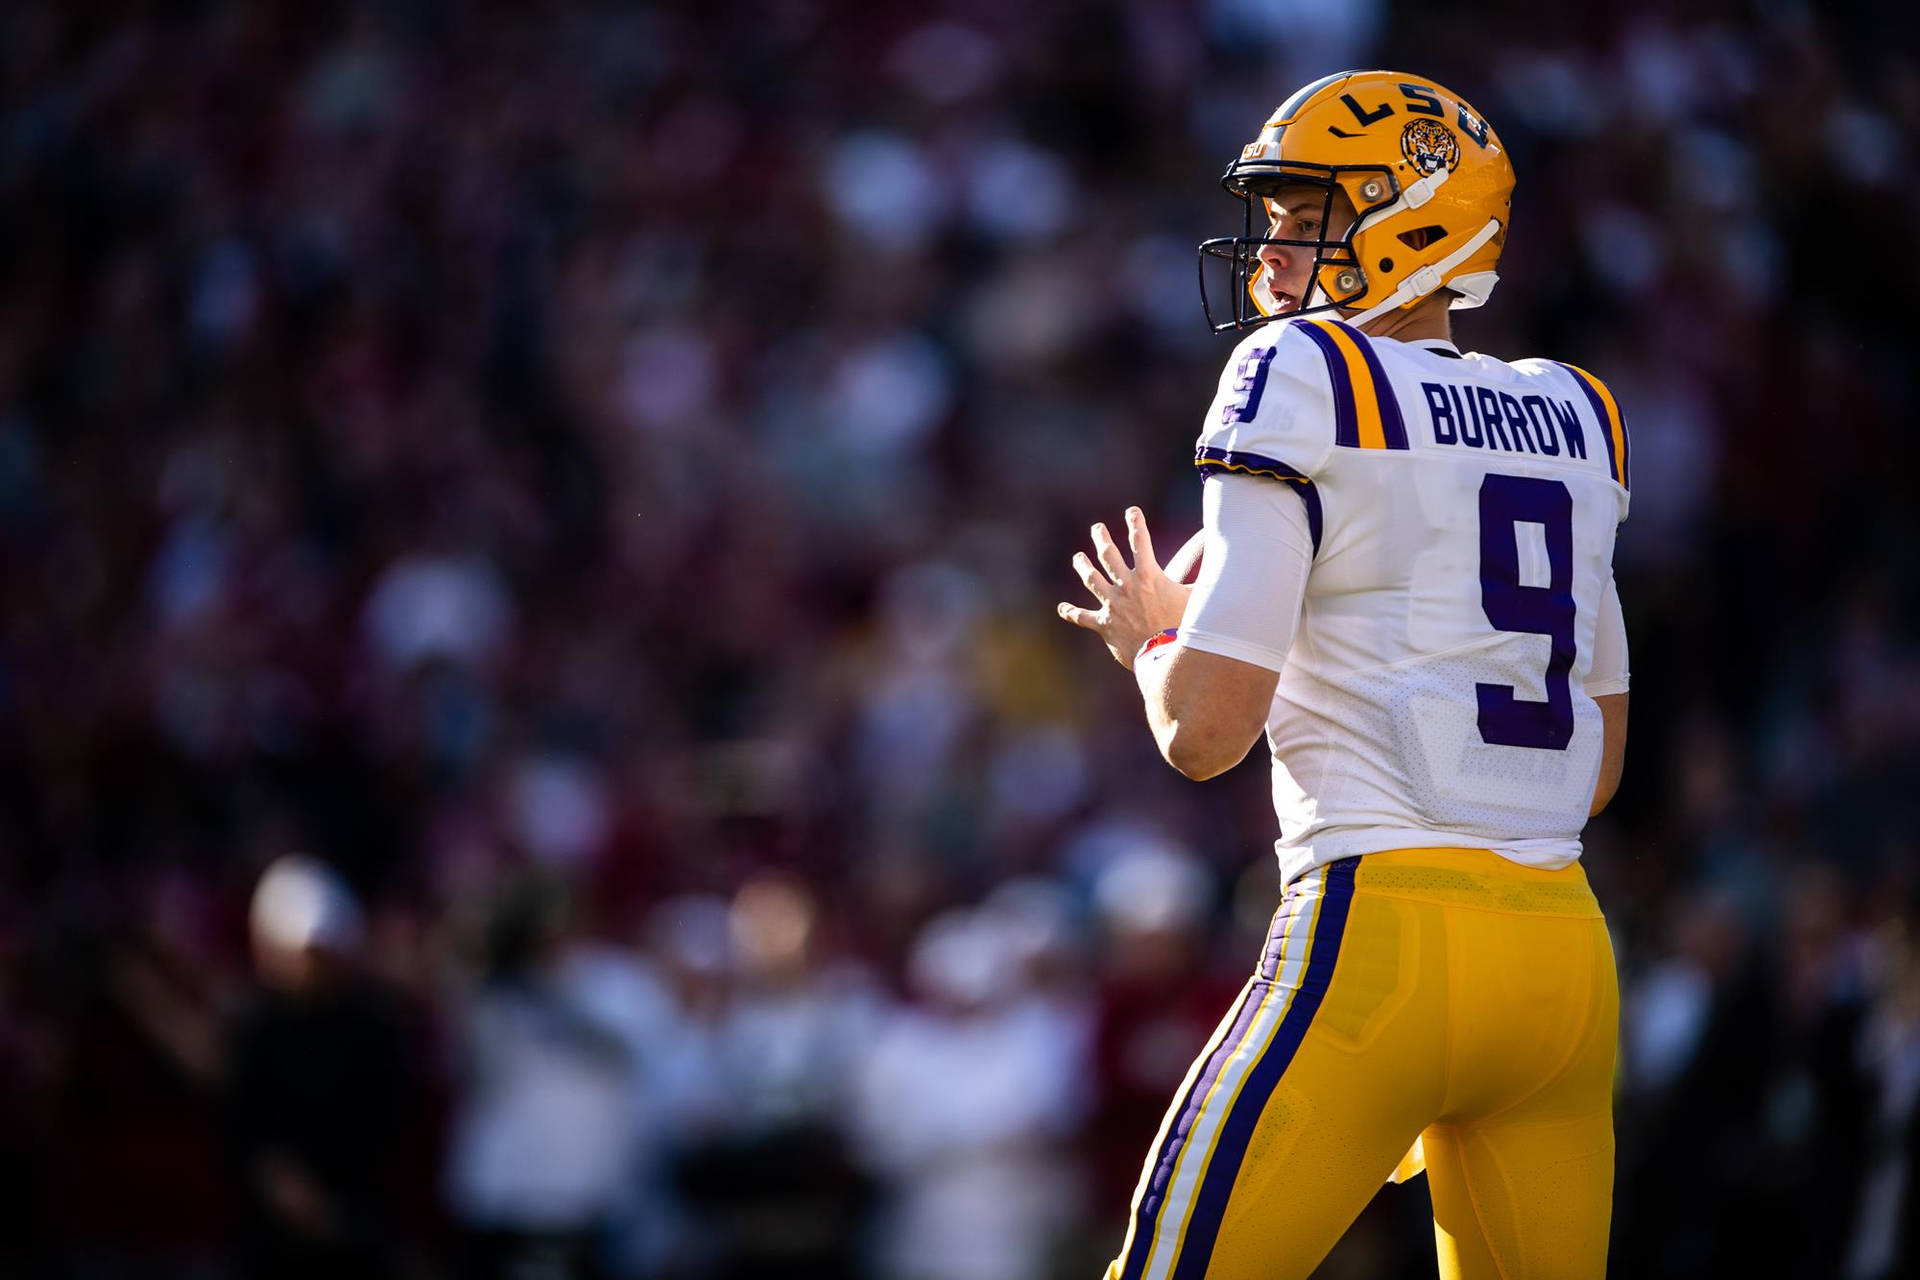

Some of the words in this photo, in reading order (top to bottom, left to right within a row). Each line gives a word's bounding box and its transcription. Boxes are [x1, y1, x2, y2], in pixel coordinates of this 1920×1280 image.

[1340, 83, 1490, 150] LSU
[1222, 346, 1277, 424] 9
[1420, 382, 1588, 460] BURROW
[1476, 473, 1577, 752] 9
